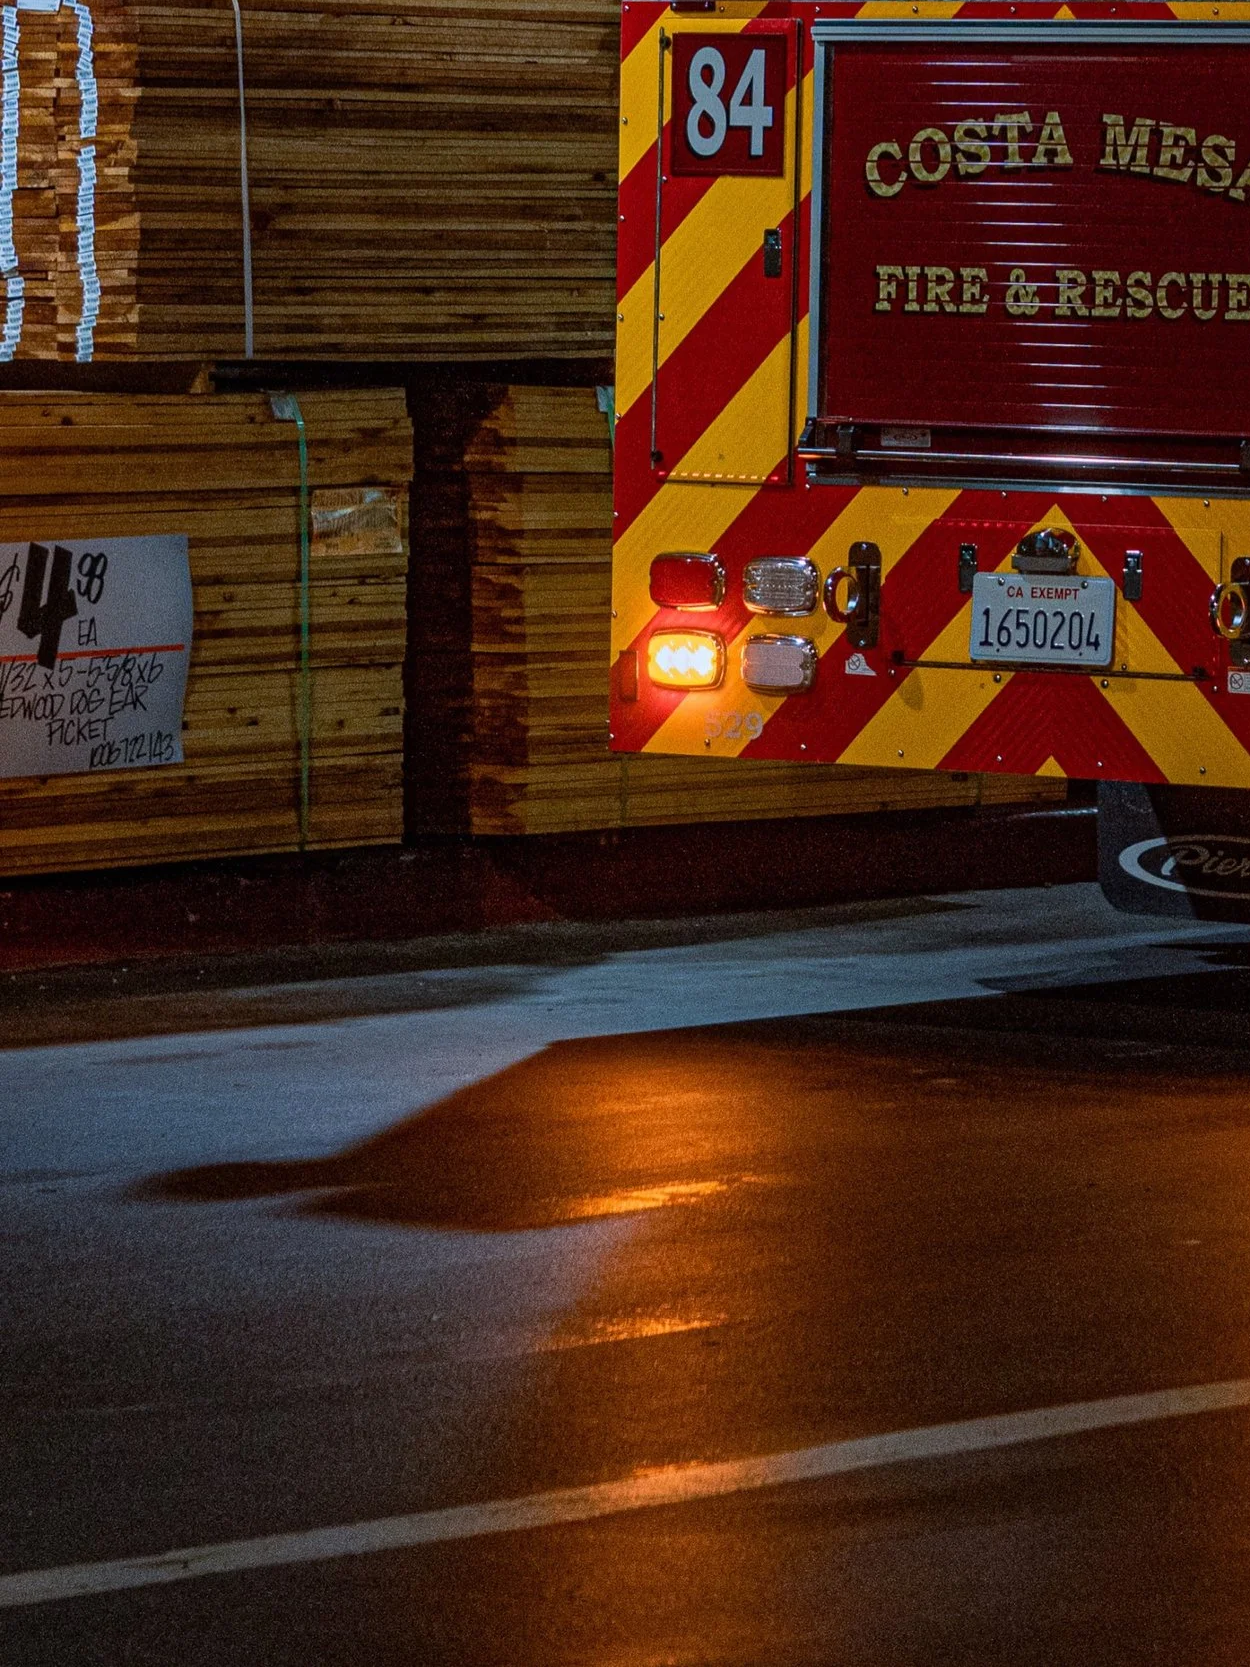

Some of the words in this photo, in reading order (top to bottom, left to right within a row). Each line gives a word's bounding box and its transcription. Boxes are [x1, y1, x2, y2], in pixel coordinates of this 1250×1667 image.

[685, 46, 774, 157] 84
[865, 111, 1074, 198] COSTA
[874, 264, 989, 314] FIRE
[1005, 267, 1041, 316] &
[1007, 585, 1024, 598] CA
[1031, 586, 1080, 601] EXEMPT
[78, 617, 97, 646] EA
[979, 606, 1101, 651] 1650204
[0, 692, 65, 721] EDWOOD
[70, 688, 105, 715] DOG
[109, 683, 147, 715] EAR
[45, 716, 114, 746] PICKET
[704, 709, 764, 740] 529
